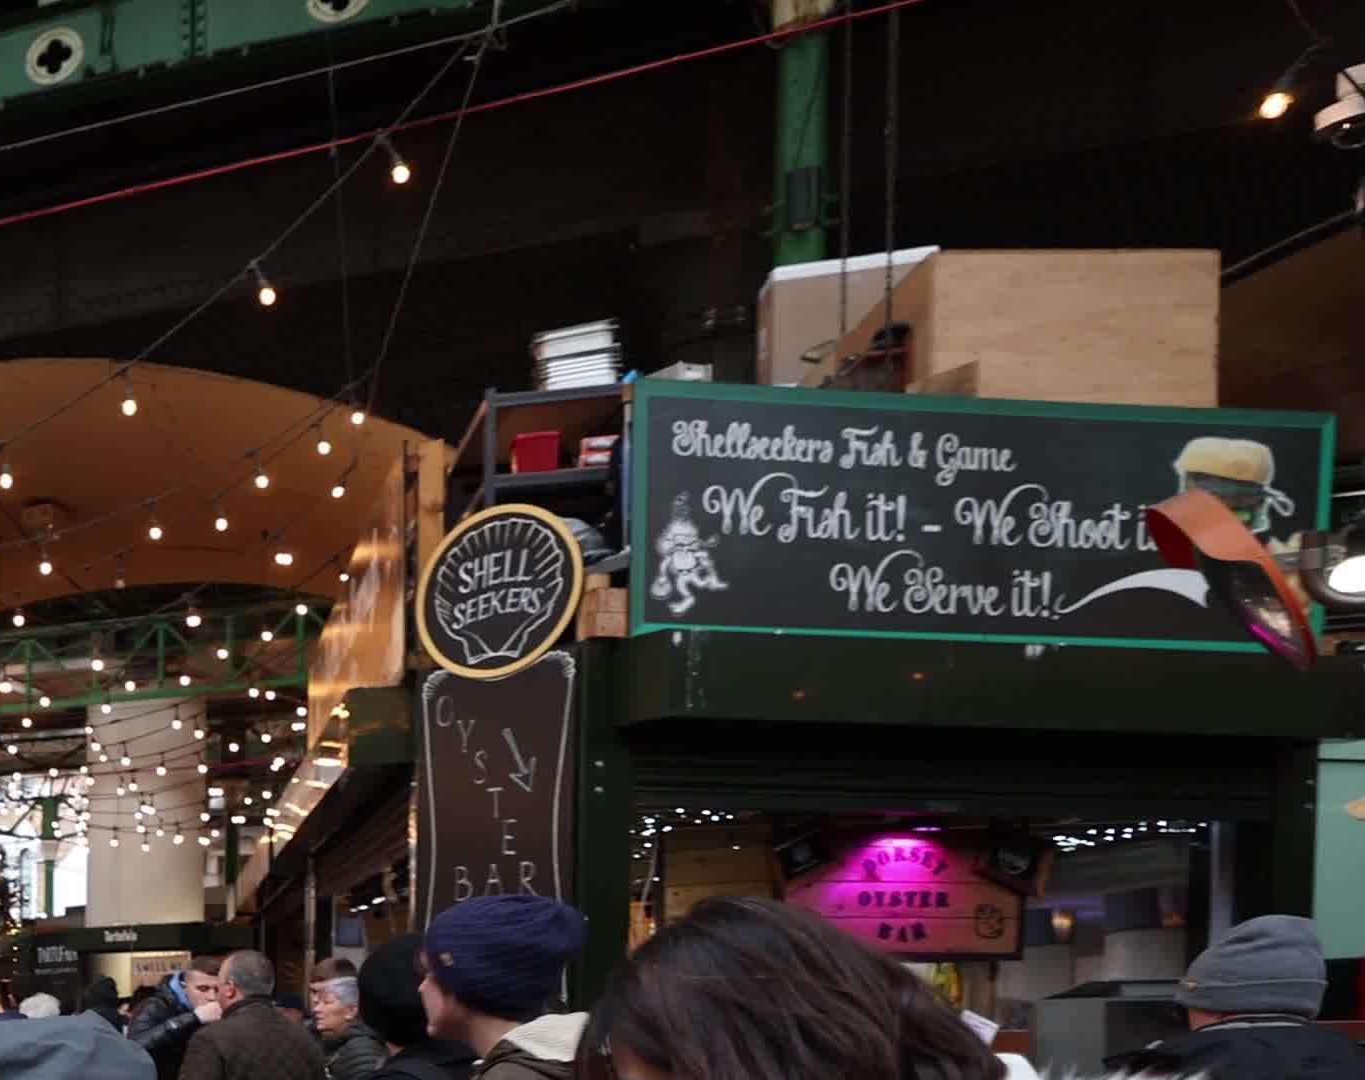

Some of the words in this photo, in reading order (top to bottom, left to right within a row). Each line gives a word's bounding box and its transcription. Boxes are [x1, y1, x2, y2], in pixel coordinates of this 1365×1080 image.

[671, 419, 835, 464] Shellseekers
[839, 424, 903, 470] Fish
[907, 431, 928, 470] &
[935, 433, 1018, 486] Game
[701, 472, 798, 537] We
[778, 485, 861, 543] Fish
[864, 492, 908, 543] it!
[954, 483, 1049, 547] We
[1028, 501, 1135, 552] Shoot
[458, 547, 534, 595] SHELL
[829, 549, 925, 613] We
[904, 566, 1006, 617] Serve
[1012, 569, 1052, 618] it!
[452, 586, 545, 633] SEEKERS
[453, 860, 541, 901] BAR
[861, 846, 949, 879] DORSET
[857, 890, 950, 908] OYSTER
[875, 922, 928, 943] BAR
